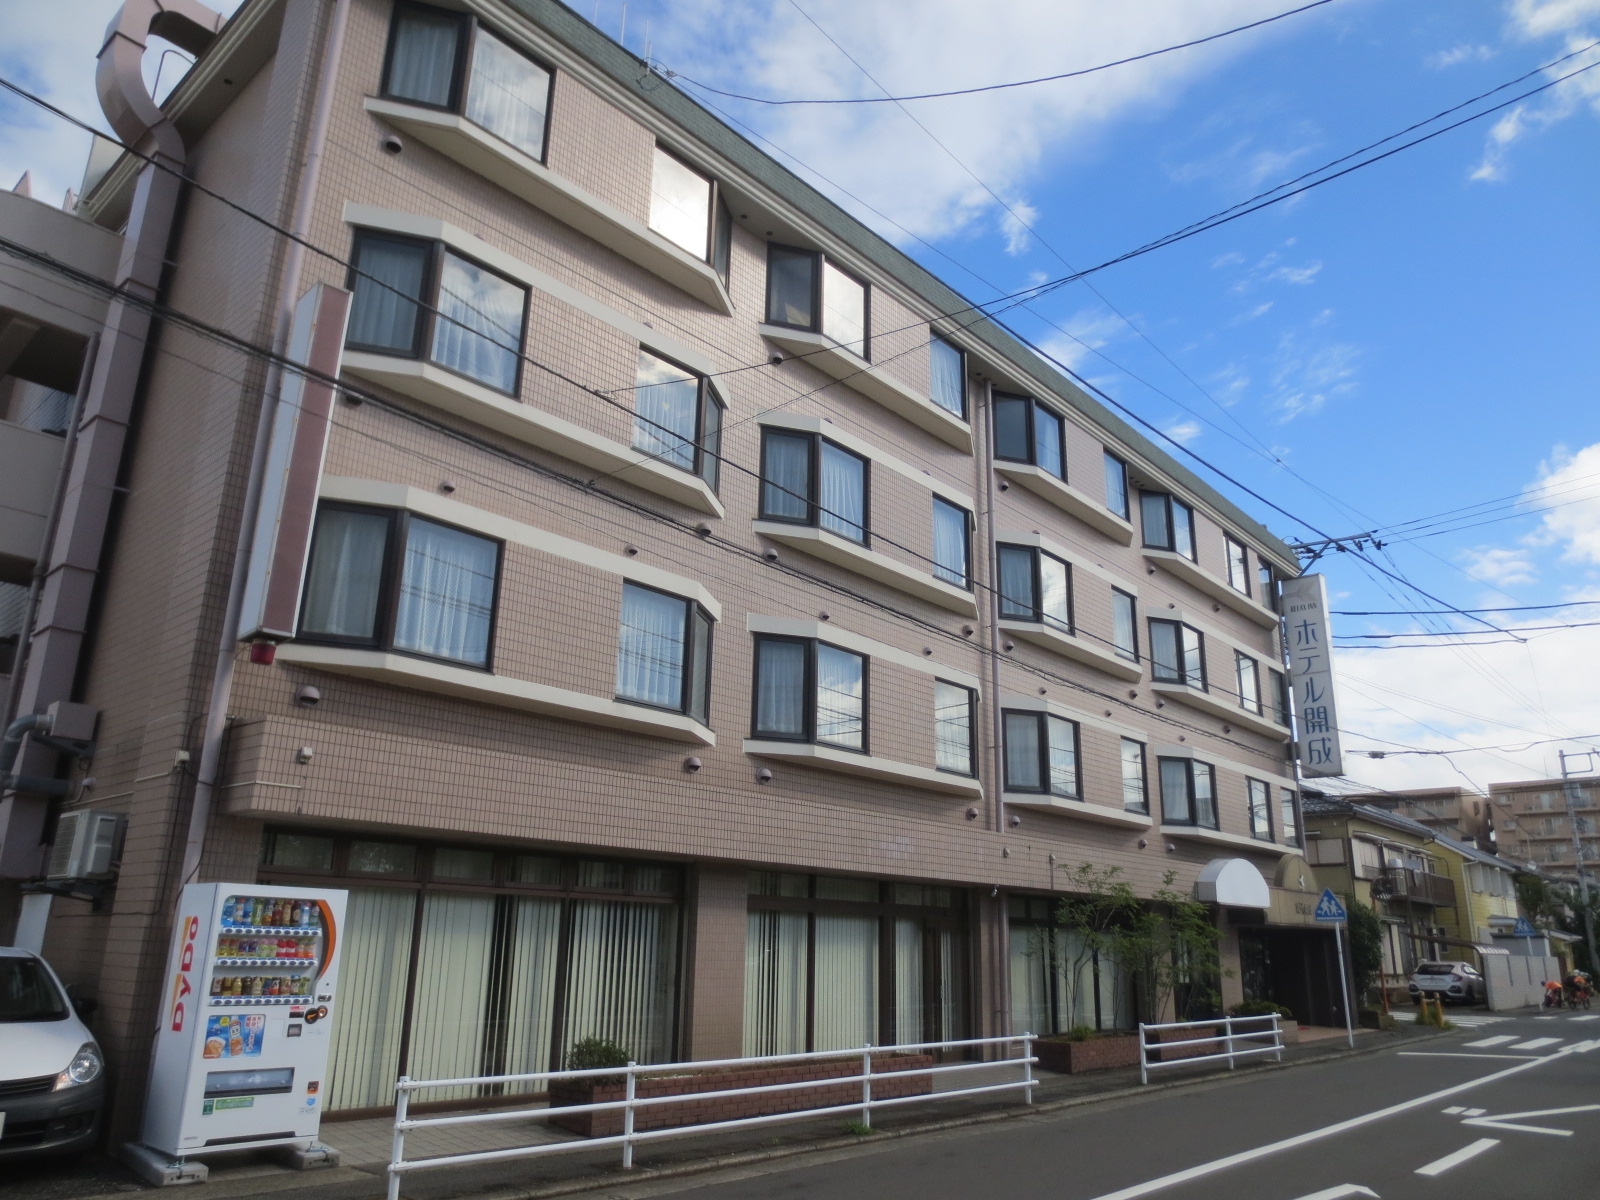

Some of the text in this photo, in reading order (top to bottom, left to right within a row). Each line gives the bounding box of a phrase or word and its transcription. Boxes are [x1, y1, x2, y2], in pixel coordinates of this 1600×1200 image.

[1294, 619, 1333, 765] ホテル開成
